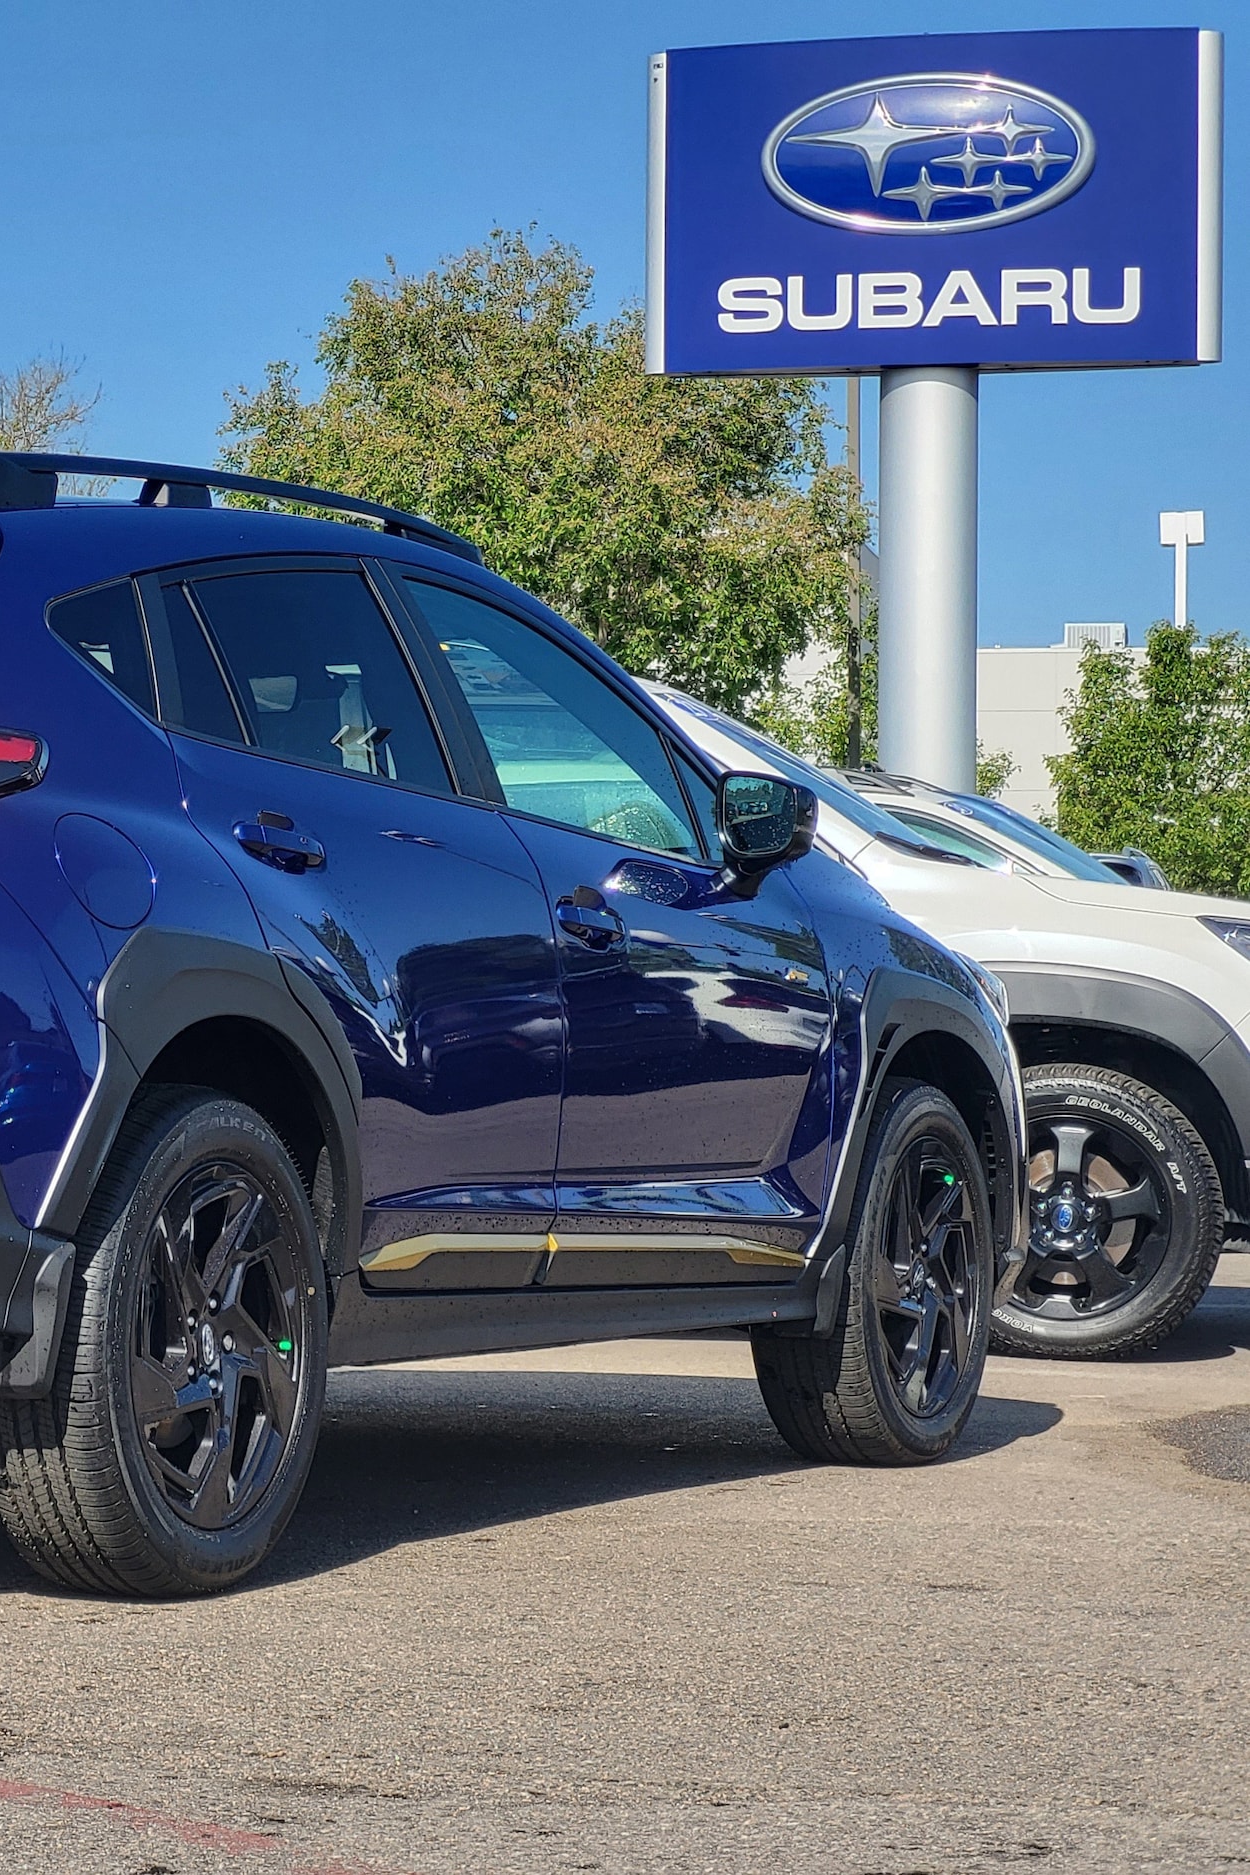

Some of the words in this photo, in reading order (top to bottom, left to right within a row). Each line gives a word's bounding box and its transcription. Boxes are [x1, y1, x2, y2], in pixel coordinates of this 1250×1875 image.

[717, 267, 1141, 334] SUBARU
[1065, 1095, 1166, 1153] GEOLANDAR
[1166, 1162, 1187, 1194] A/T
